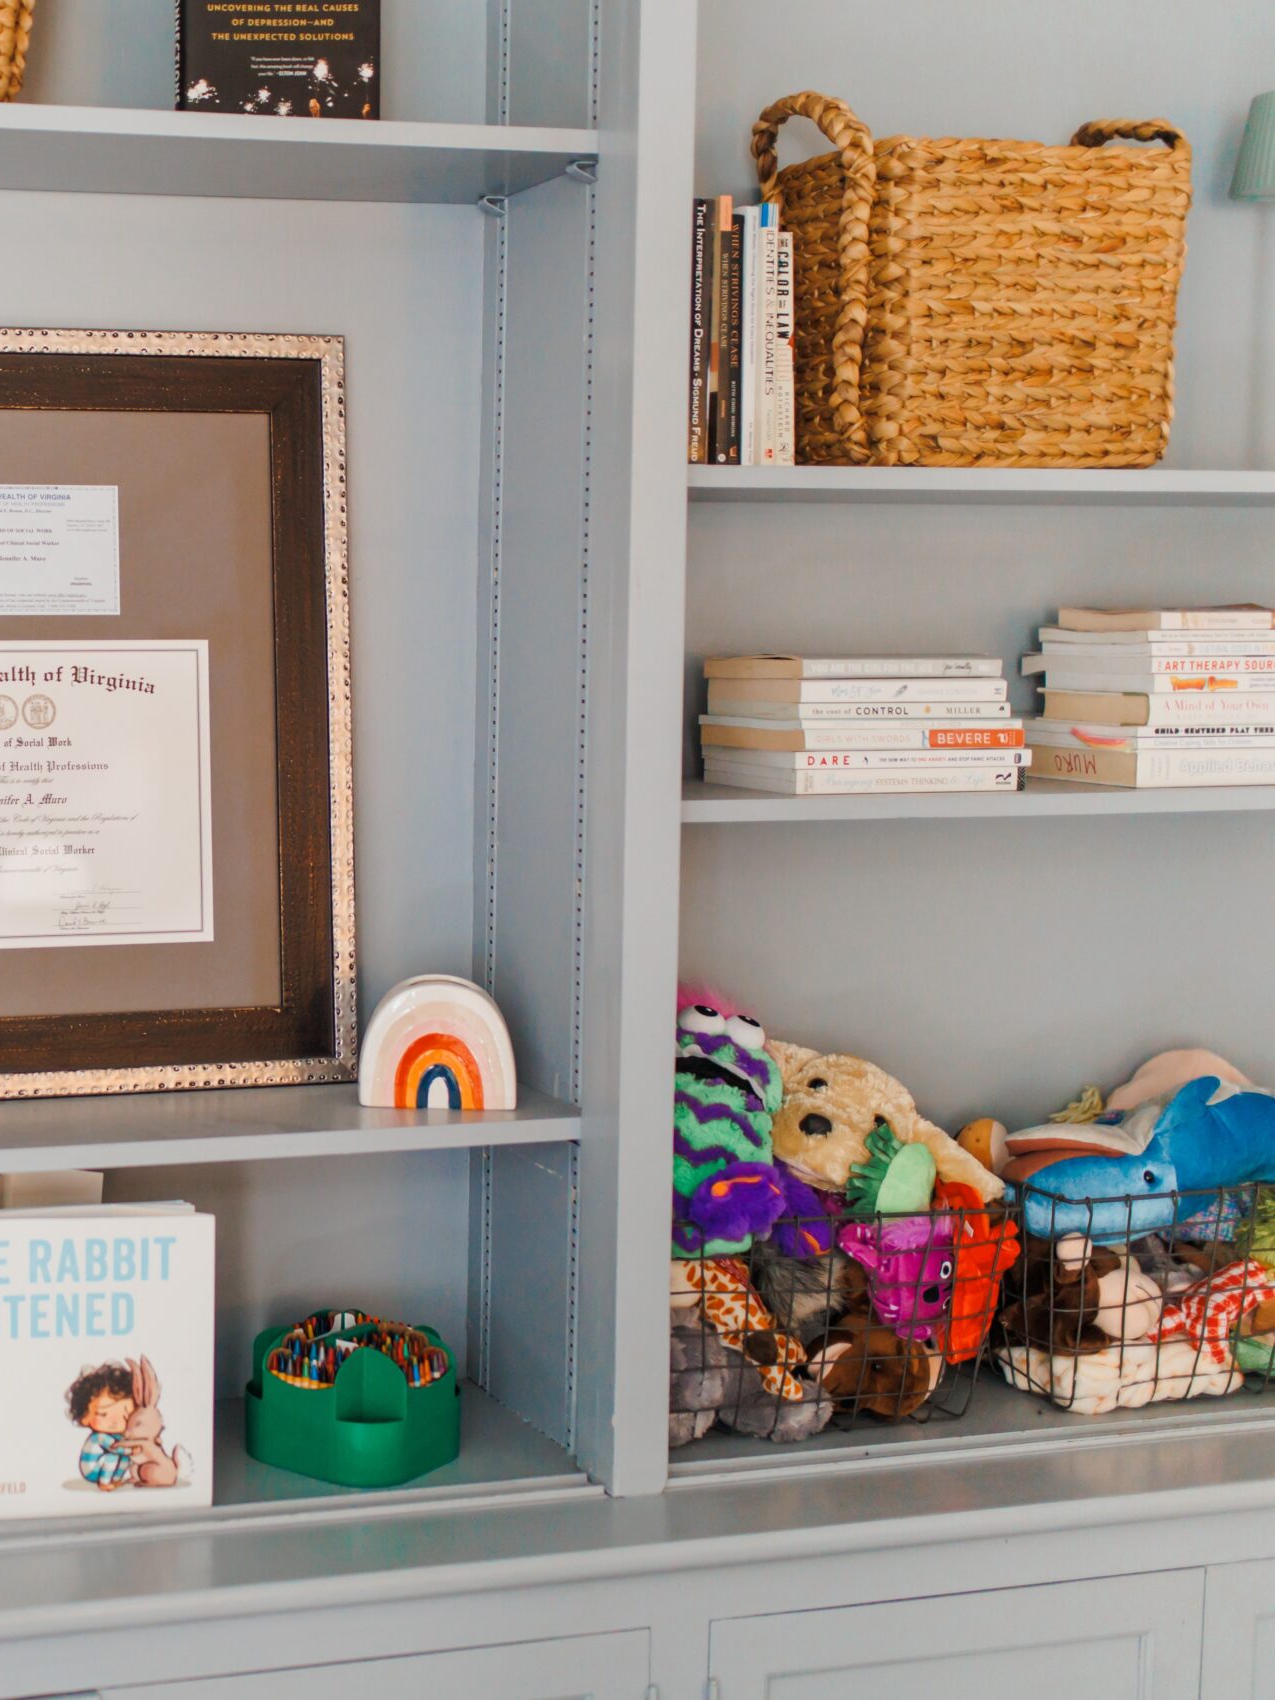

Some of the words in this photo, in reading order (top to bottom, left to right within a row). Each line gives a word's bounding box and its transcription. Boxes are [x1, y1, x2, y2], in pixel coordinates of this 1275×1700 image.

[208, 4, 271, 12] UNCOVERING
[275, 4, 292, 12] THE
[296, 4, 319, 12] REAL
[322, 4, 359, 12] CAUSES
[233, 33, 296, 41] UNEXPECTED
[696, 204, 706, 225] THE
[731, 224, 739, 257] WHEN
[694, 228, 706, 311] INTERPRETATION
[721, 253, 729, 276] WHEN
[765, 230, 775, 295] IDENTITIES
[731, 263, 739, 325] STRIVINGS
[694, 314, 702, 326] OF
[777, 313, 789, 340] LAW
[720, 324, 728, 348] CEASE
[693, 328, 704, 371] DREAMS
[730, 331, 739, 368] CEASE
[765, 313, 774, 395] INEQUALITIES
[692, 379, 701, 424] SIGMUND
[691, 428, 701, 461] FREUD
[829, 664, 845, 673] ARE
[848, 664, 861, 672] THE
[883, 664, 898, 672] FOR
[900, 664, 915, 672] THE
[1165, 661, 1185, 670] ART
[1189, 661, 1240, 670] THERAPY
[43, 666, 64, 683] of
[71, 665, 156, 695] Virginia
[856, 707, 909, 715] CONTROL
[1164, 701, 1170, 711] A
[1174, 700, 1201, 711] Mind
[1205, 700, 1215, 710] of
[1221, 699, 1243, 710] Your
[1246, 700, 1269, 712] Own
[3, 737, 12, 748] of
[15, 737, 44, 748] Social
[47, 736, 72, 747] Work
[846, 735, 869, 743] WITH
[872, 735, 910, 743] SWORDS
[938, 733, 991, 745] BEVERE
[9, 761, 42, 773] Health
[46, 760, 109, 773] Professions
[807, 756, 850, 765] DARE
[1054, 754, 1097, 775] MURO
[1180, 758, 1232, 776] Applied
[875, 778, 908, 786] SYSTEMS
[910, 777, 948, 785] THINKING
[38, 793, 68, 805] Muro
[32, 845, 59, 856] Social
[64, 845, 95, 855] Worker
[29, 1236, 177, 1284] RABBIT
